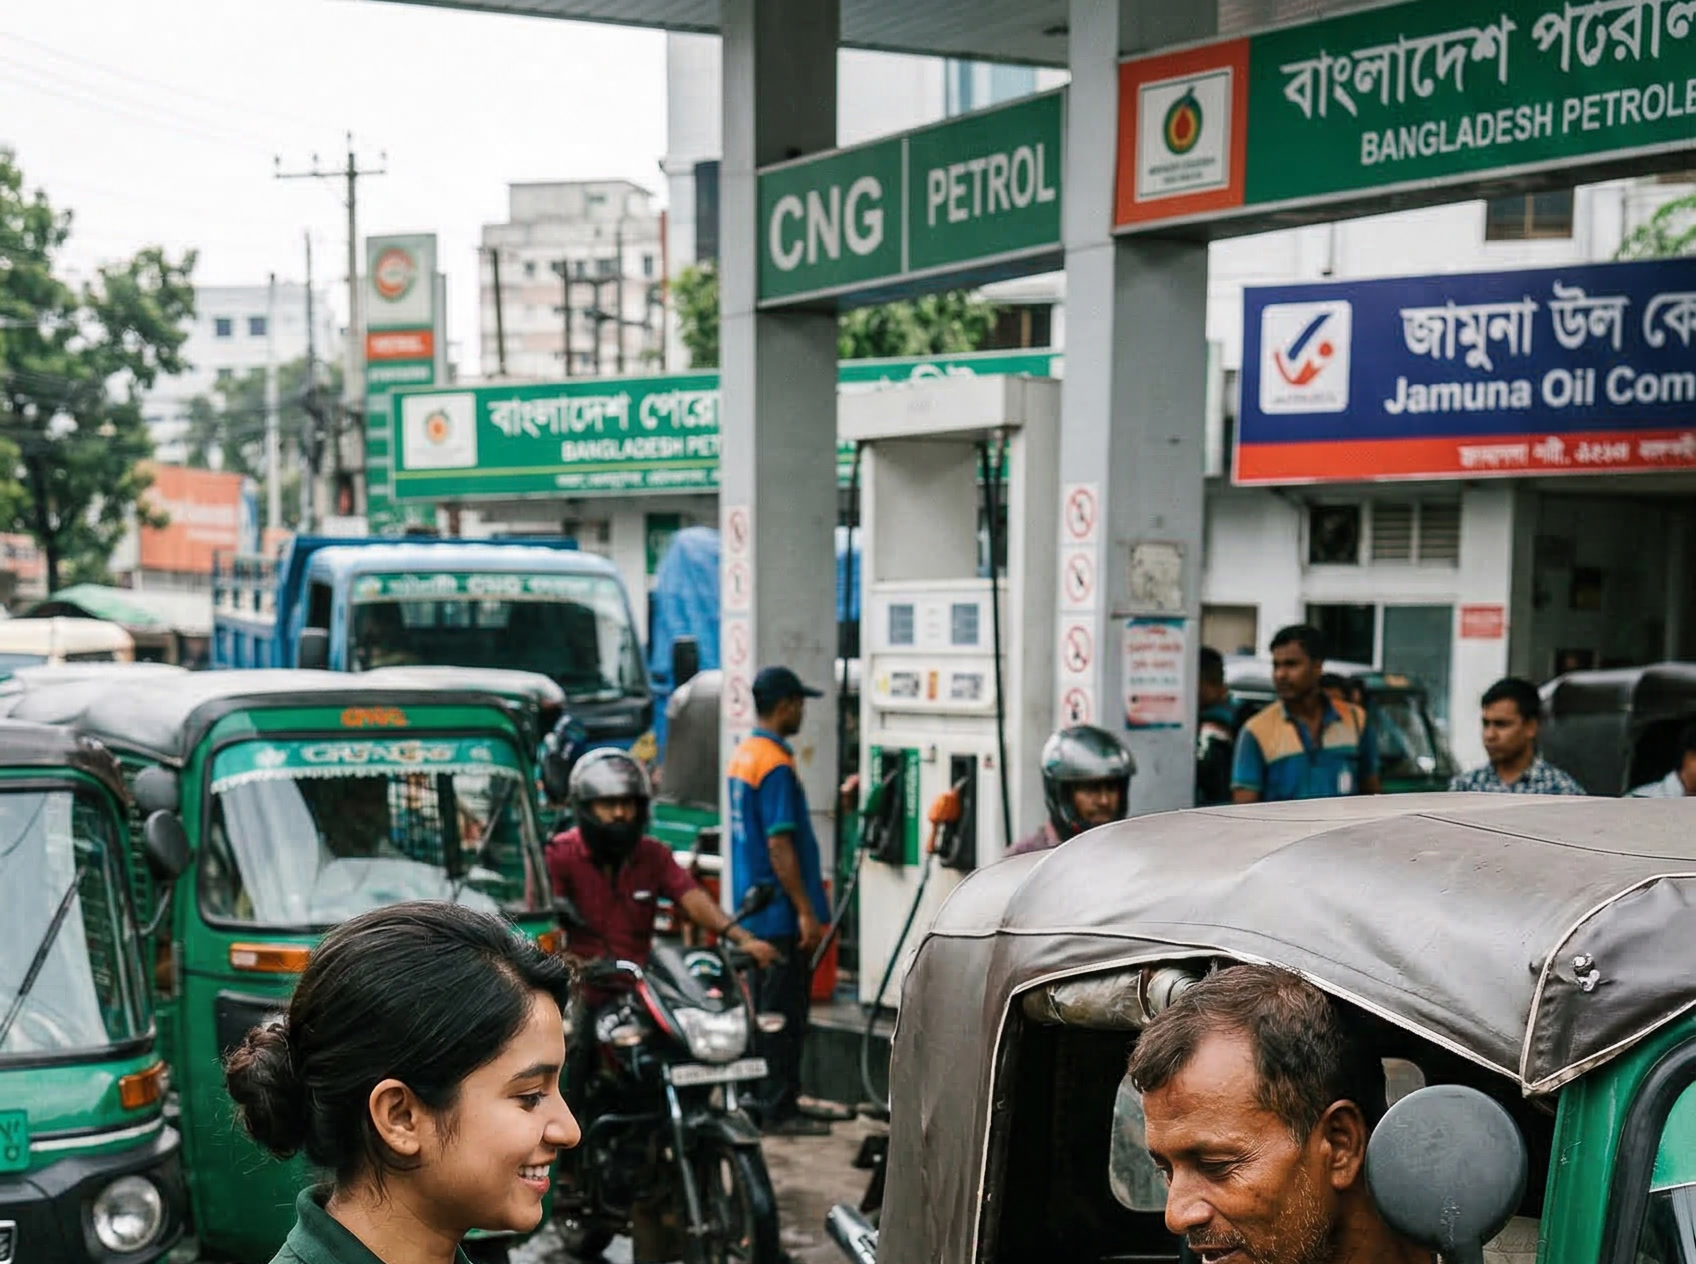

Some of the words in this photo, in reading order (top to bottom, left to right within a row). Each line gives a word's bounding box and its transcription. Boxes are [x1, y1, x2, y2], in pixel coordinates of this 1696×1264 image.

[1279, 14, 1517, 120] বাংলাদেশ
[1360, 100, 1553, 166] BANGLADESH
[768, 176, 884, 271] CNG
[926, 142, 1056, 228] PETROL
[1400, 294, 1538, 372] জামুনা
[1384, 375, 1532, 415] Jamuna
[1541, 367, 1597, 408] Oil
[1606, 365, 1696, 405] Com
